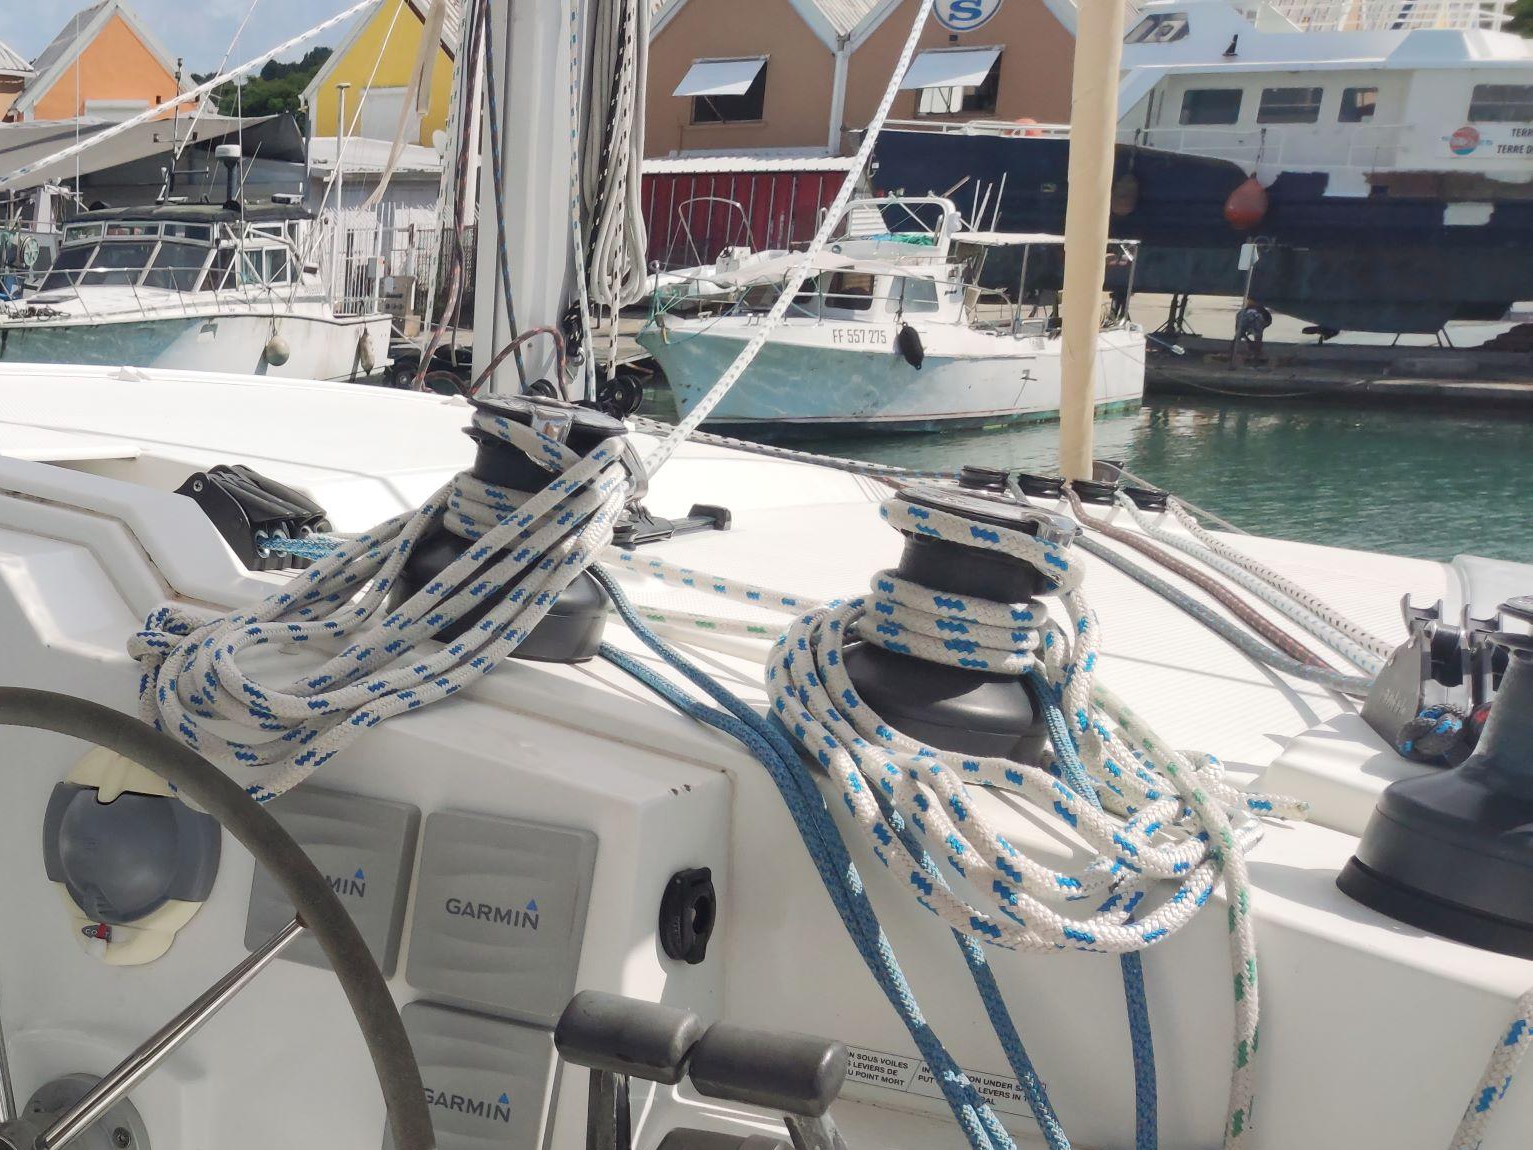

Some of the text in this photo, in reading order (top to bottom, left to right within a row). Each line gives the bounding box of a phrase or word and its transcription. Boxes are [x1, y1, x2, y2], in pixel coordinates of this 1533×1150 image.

[1496, 144, 1525, 154] TERRE
[832, 328, 887, 344] FF 557 275
[326, 875, 366, 898] MIN
[446, 898, 540, 931] GARMIN
[853, 1062, 885, 1074] LEVIERS
[887, 1068, 898, 1076] DE
[856, 1054, 878, 1062] SOUS
[880, 1058, 908, 1069] VOILES
[856, 1070, 880, 1080] POINT
[881, 1076, 904, 1086] MORT
[970, 1076, 982, 1084] ON
[983, 1078, 1012, 1090] UNDER
[918, 1074, 934, 1084] PUT
[978, 1086, 1010, 1099] LEVERS
[1012, 1092, 1021, 1100] IN
[421, 1088, 511, 1124] GARMIN
